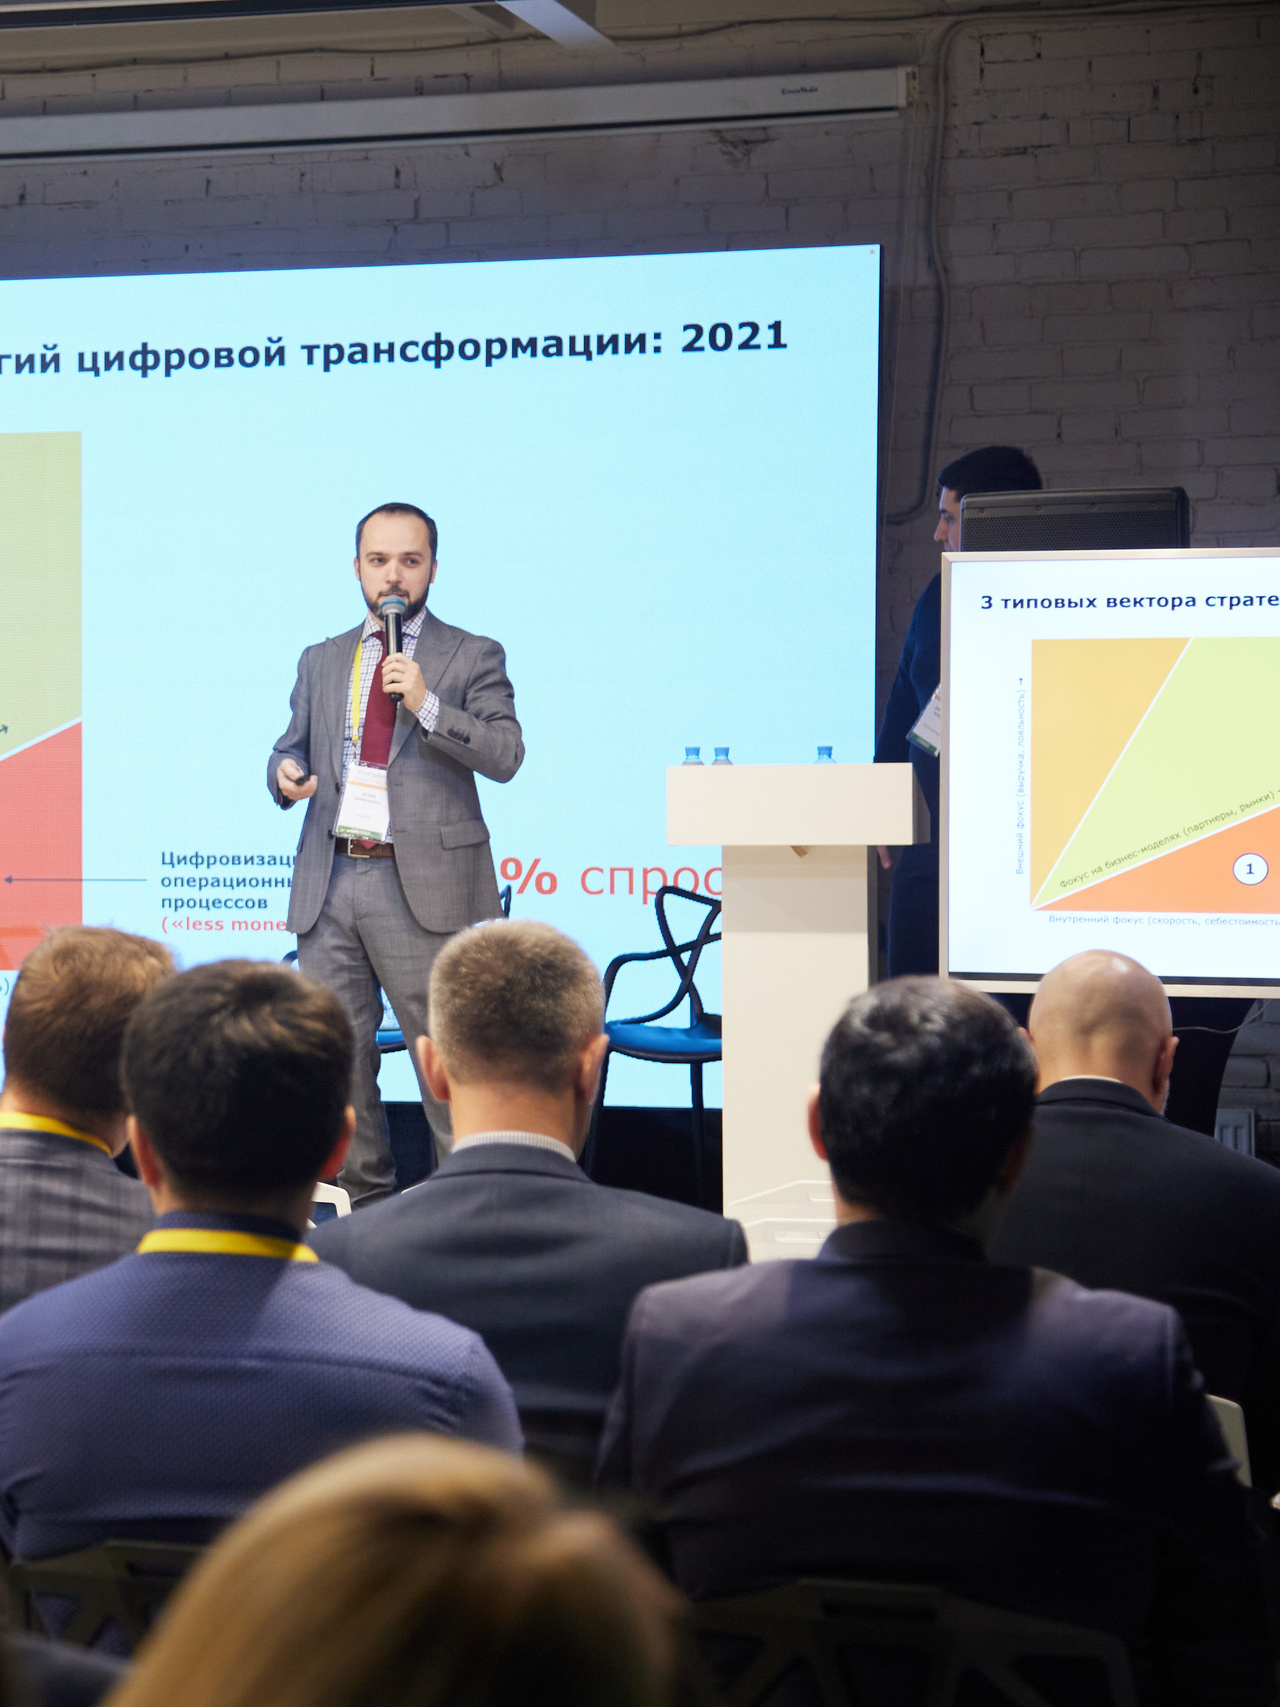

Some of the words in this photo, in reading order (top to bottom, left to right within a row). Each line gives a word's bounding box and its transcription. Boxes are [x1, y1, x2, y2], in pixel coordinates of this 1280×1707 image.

[77, 336, 287, 378] цифровой
[301, 331, 664, 373] трансформации:
[681, 320, 789, 353] 2021
[980, 595, 993, 609] 3
[1001, 597, 1098, 609] типовых
[1106, 595, 1197, 611] вектора
[1205, 594, 1280, 610] страте
[1059, 872, 1090, 888] Фокус
[1091, 865, 1104, 875] на
[1104, 832, 1182, 869] бизнес-моделях
[1182, 809, 1238, 837] (партнеры,
[1239, 790, 1276, 813] рынки)
[161, 851, 296, 869] Цифровизац
[1245, 863, 1255, 875] 1
[161, 897, 268, 912] процессов
[161, 916, 224, 934] («less
[231, 919, 288, 932] mone
[1048, 915, 1110, 925] Внутренний
[1112, 916, 1145, 926] фокус
